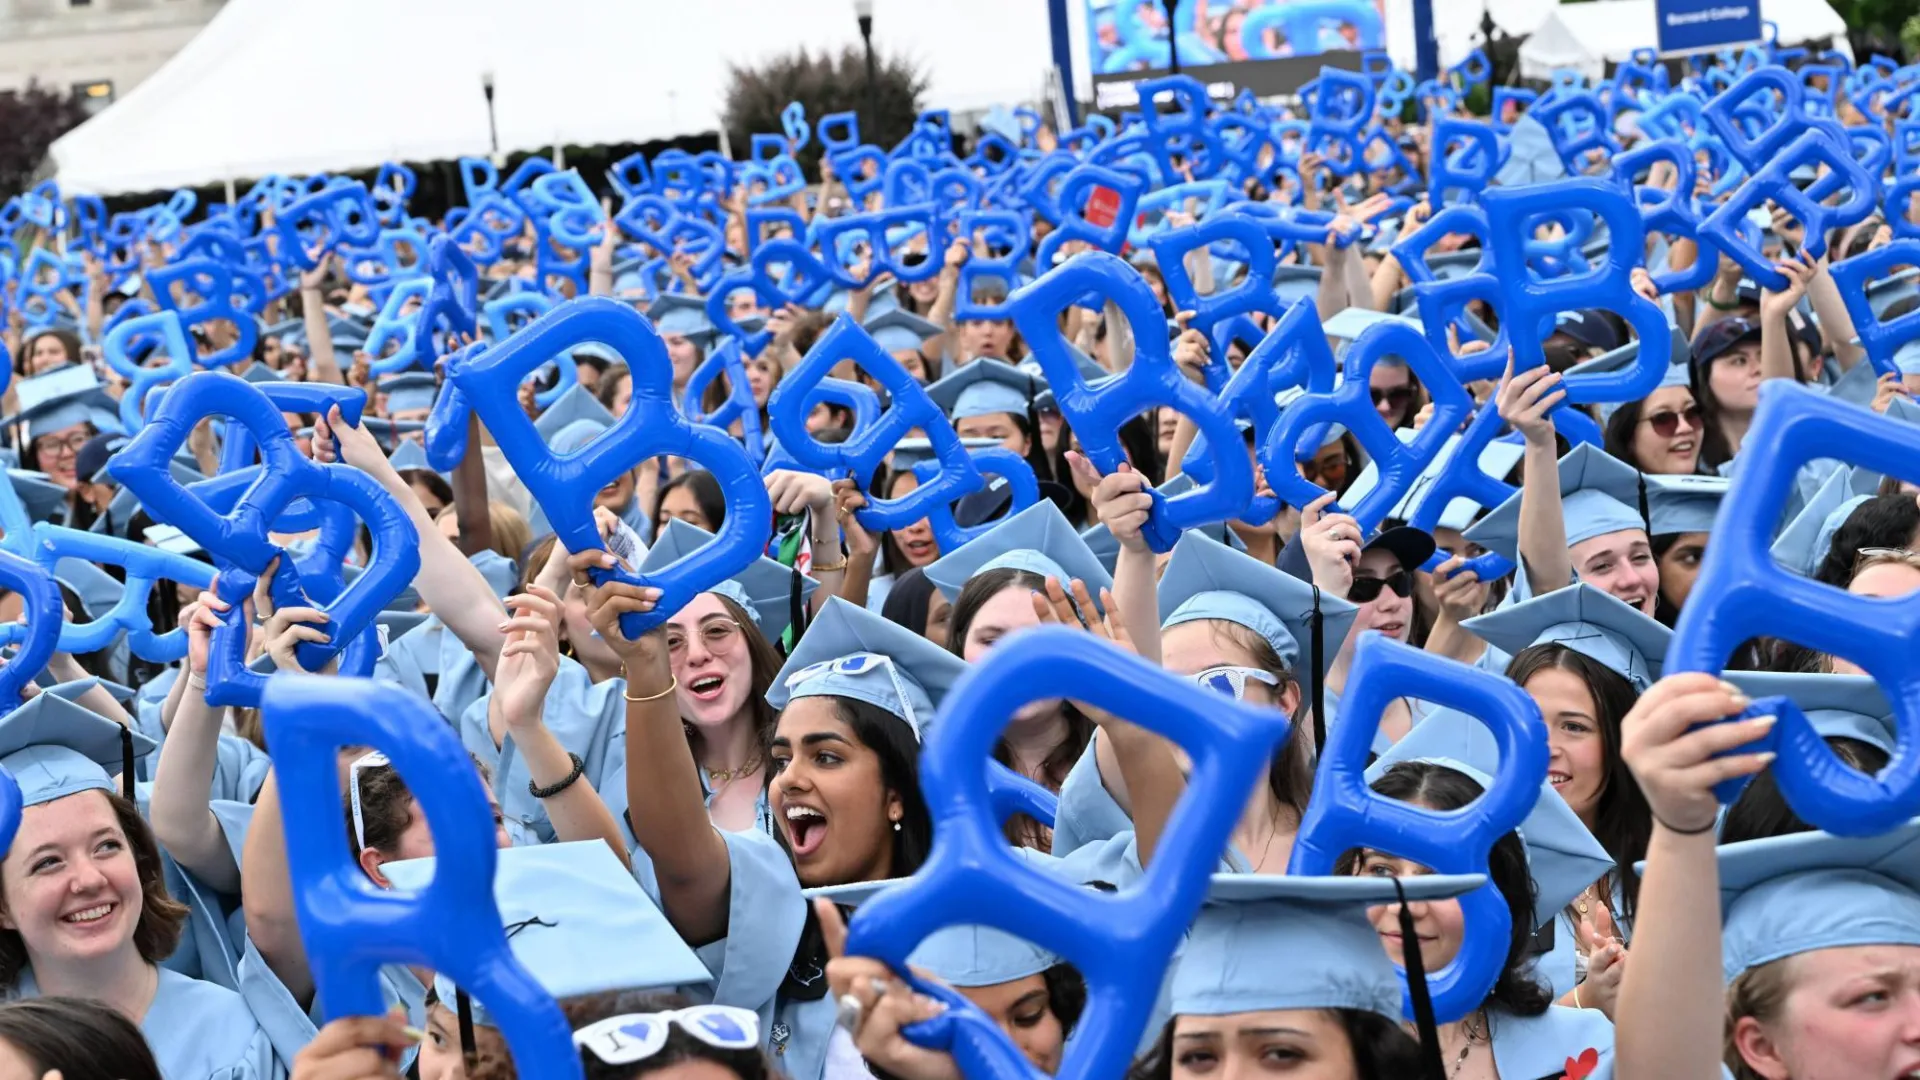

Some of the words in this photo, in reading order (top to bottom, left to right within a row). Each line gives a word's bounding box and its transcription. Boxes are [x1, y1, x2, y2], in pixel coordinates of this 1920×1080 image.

[1009, 250, 1254, 552] B
[1479, 177, 1671, 415] B
[451, 297, 771, 640] B
